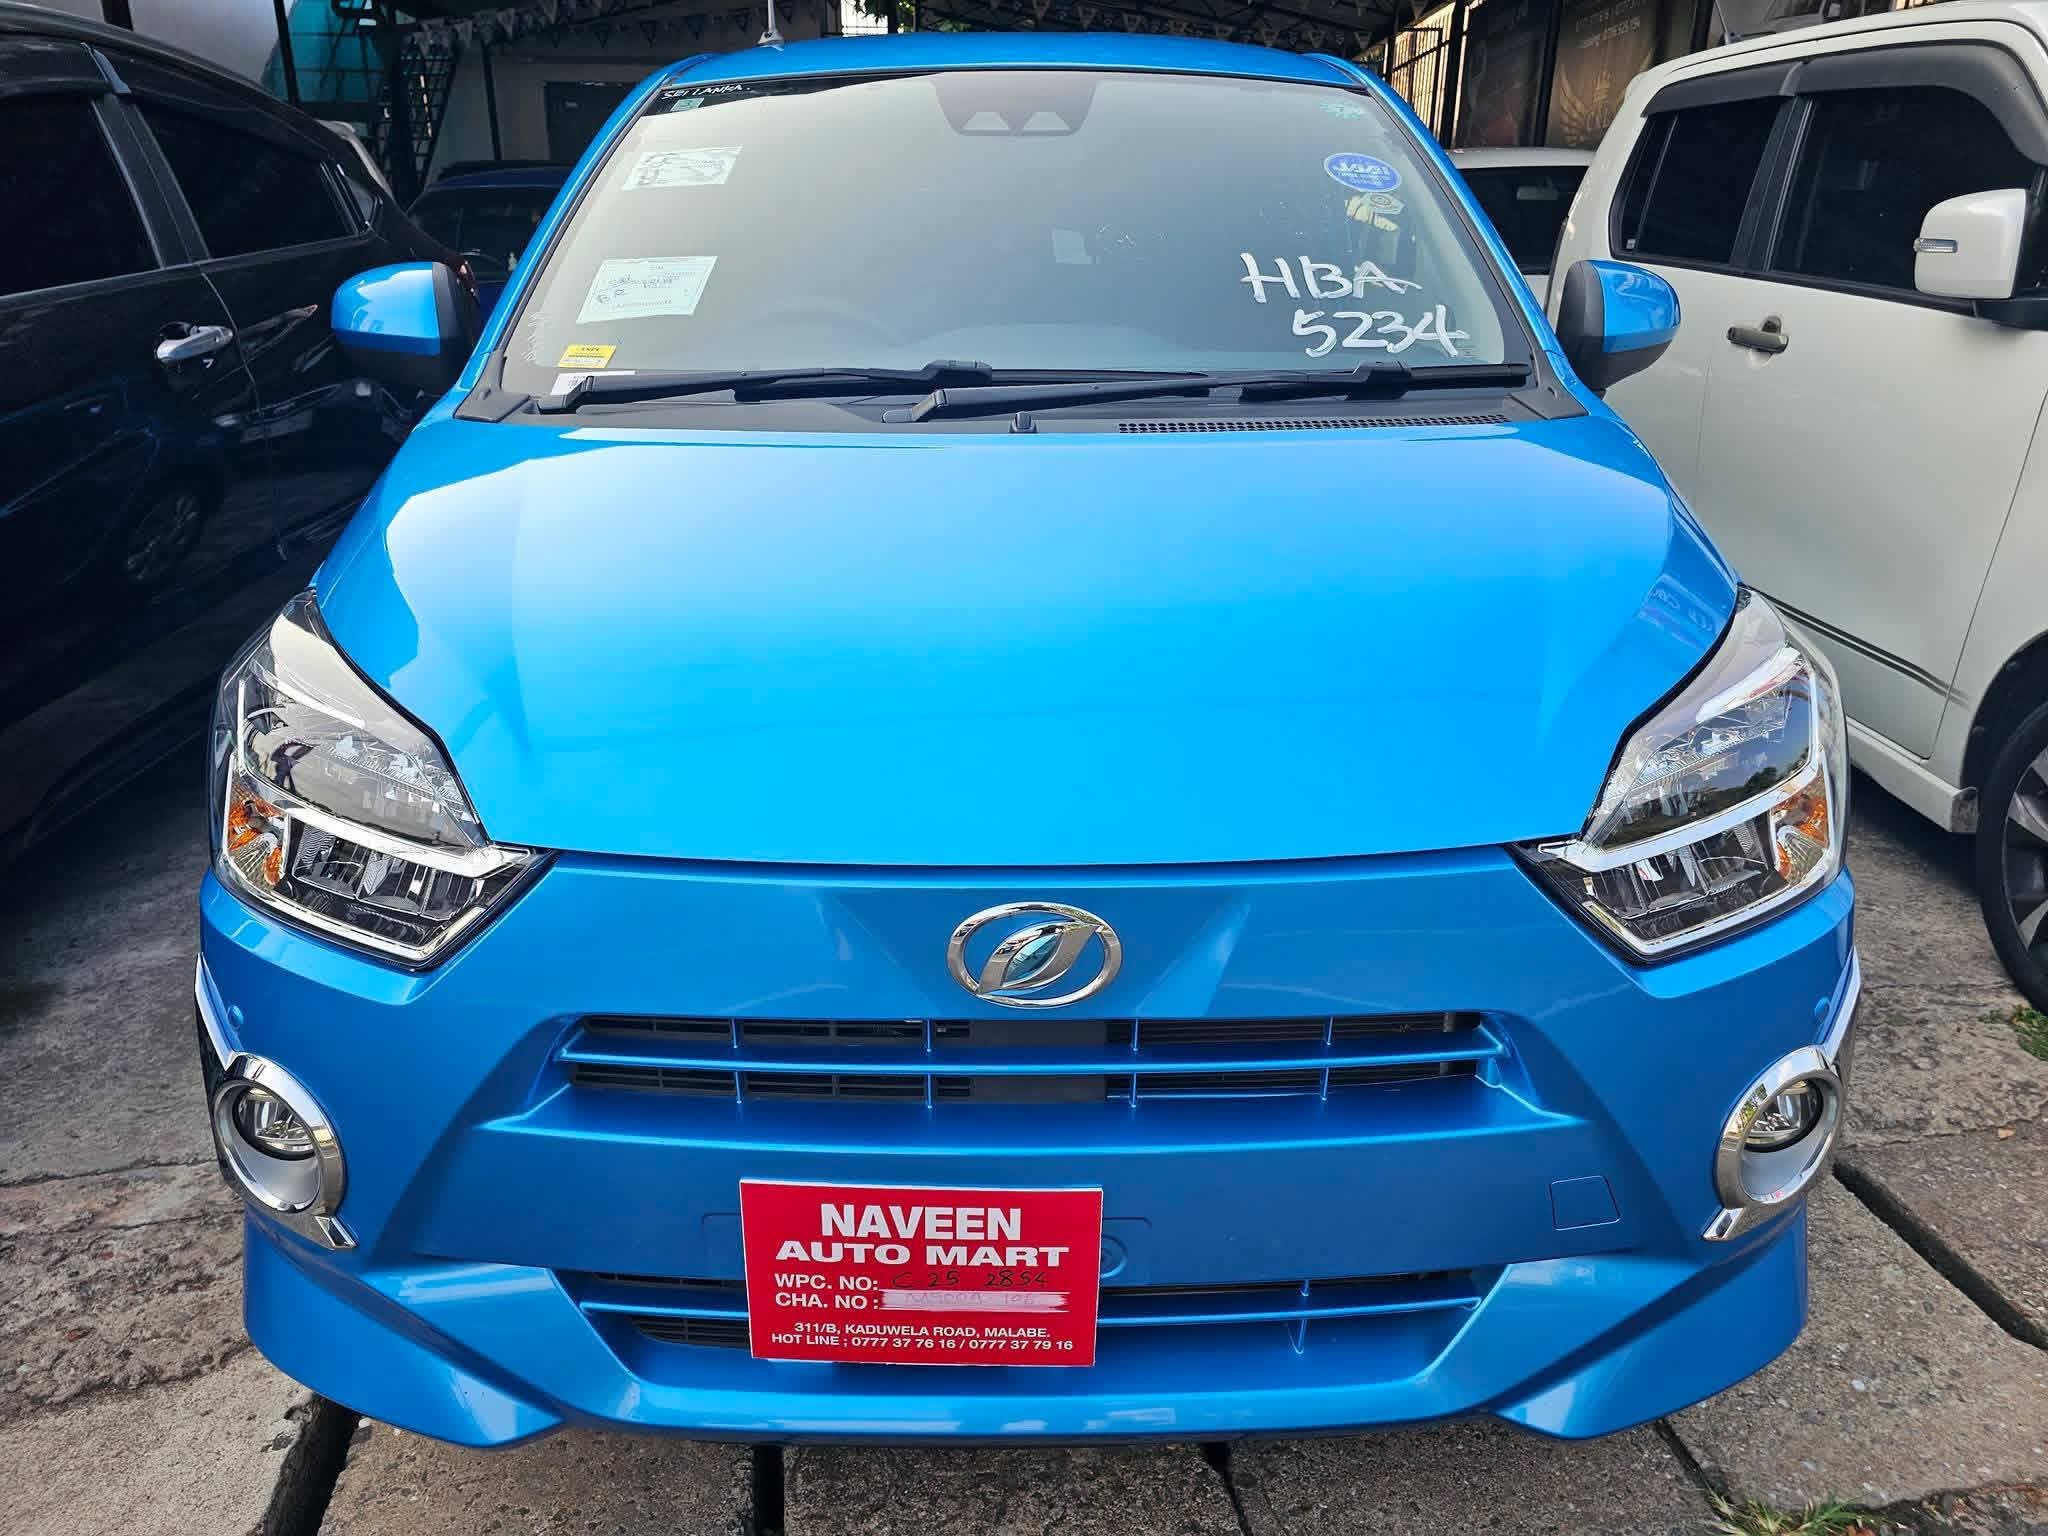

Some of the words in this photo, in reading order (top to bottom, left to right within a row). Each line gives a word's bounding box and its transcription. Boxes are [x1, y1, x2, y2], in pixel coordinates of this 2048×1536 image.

[1240, 252, 1423, 303] HBA
[1292, 304, 1471, 358] 5234
[820, 1203, 1022, 1241] NAVEEN
[775, 1240, 911, 1265] AUTO
[926, 1245, 1070, 1267] MART
[774, 1273, 833, 1290] WPC.
[839, 1275, 879, 1291] NO:
[775, 1291, 829, 1308] CHA.
[834, 1294, 868, 1310] NO
[771, 1333, 803, 1344] HOT
[806, 1334, 840, 1346] LINE
[851, 1337, 889, 1347] 0777
[892, 1338, 912, 1348] 37
[915, 1338, 934, 1349] 76
[938, 1339, 956, 1349] 16
[968, 1339, 1007, 1349] 0777
[1010, 1340, 1029, 1350] 37
[1032, 1340, 1052, 1350] 79
[1055, 1340, 1073, 1351] 16
[794, 1322, 841, 1335] 311/B,
[845, 1324, 930, 1336] KADUWELA
[933, 1326, 980, 1339] ROAD,
[984, 1327, 1051, 1338] MALABE.
